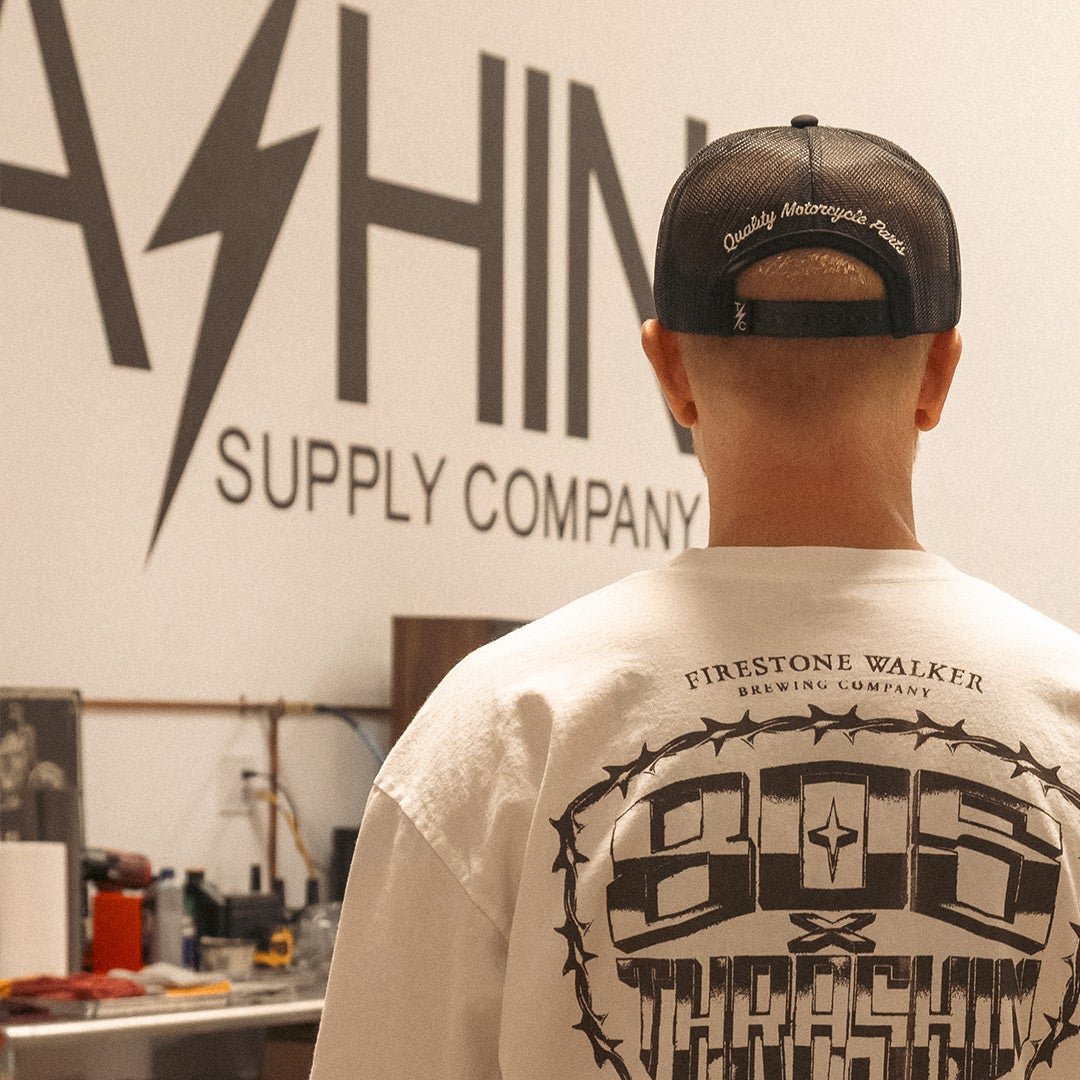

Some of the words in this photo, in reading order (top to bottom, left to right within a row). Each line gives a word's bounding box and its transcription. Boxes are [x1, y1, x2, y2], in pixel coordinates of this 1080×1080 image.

[723, 210, 776, 253] Quality
[780, 201, 868, 225] Motorcycle
[869, 219, 906, 256] Parts
[215, 425, 447, 525] SUPPLY
[463, 461, 702, 551] COMPANY
[685, 653, 852, 690] FIRESTONE
[863, 654, 984, 694] WALKER
[738, 678, 828, 697] BREWING
[838, 679, 932, 698] COMPANY
[606, 759, 1063, 954] 805
